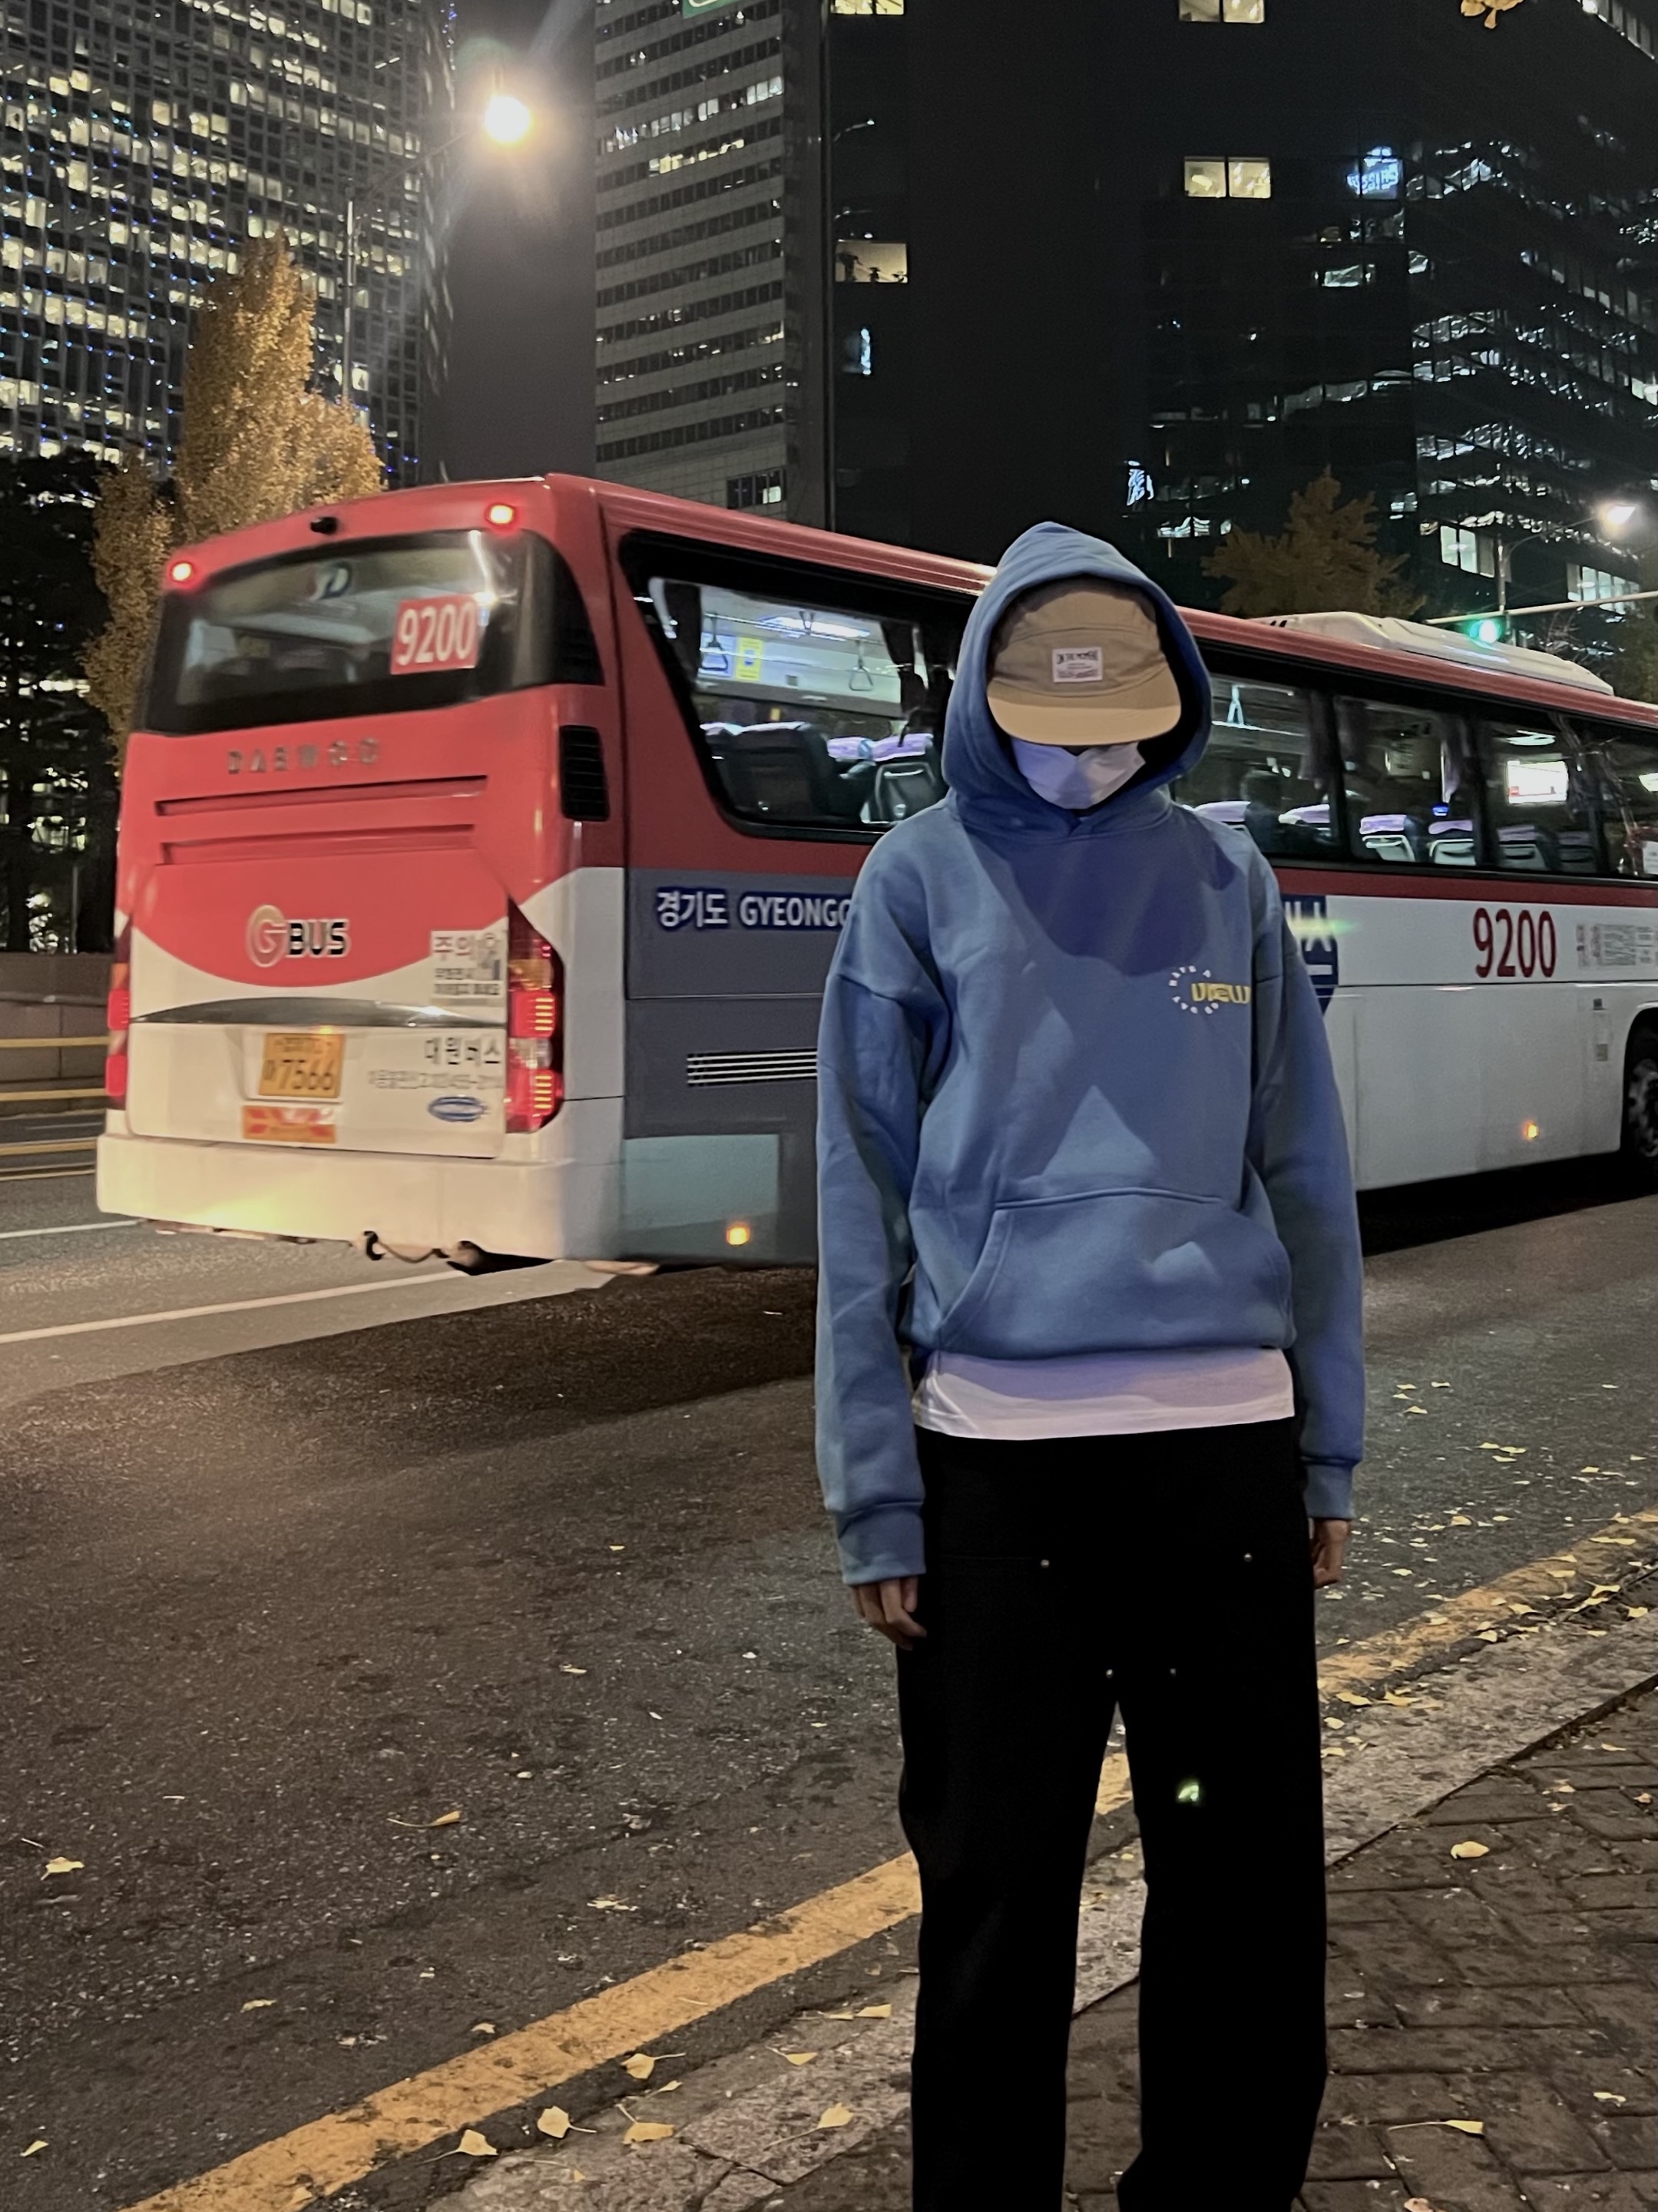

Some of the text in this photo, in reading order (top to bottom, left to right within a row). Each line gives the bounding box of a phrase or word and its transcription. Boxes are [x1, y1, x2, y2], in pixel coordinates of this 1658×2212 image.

[396, 602, 478, 666] 9200
[227, 736, 378, 775] DAEWOO
[657, 890, 728, 928] 경기도
[1473, 908, 1557, 979] 9200
